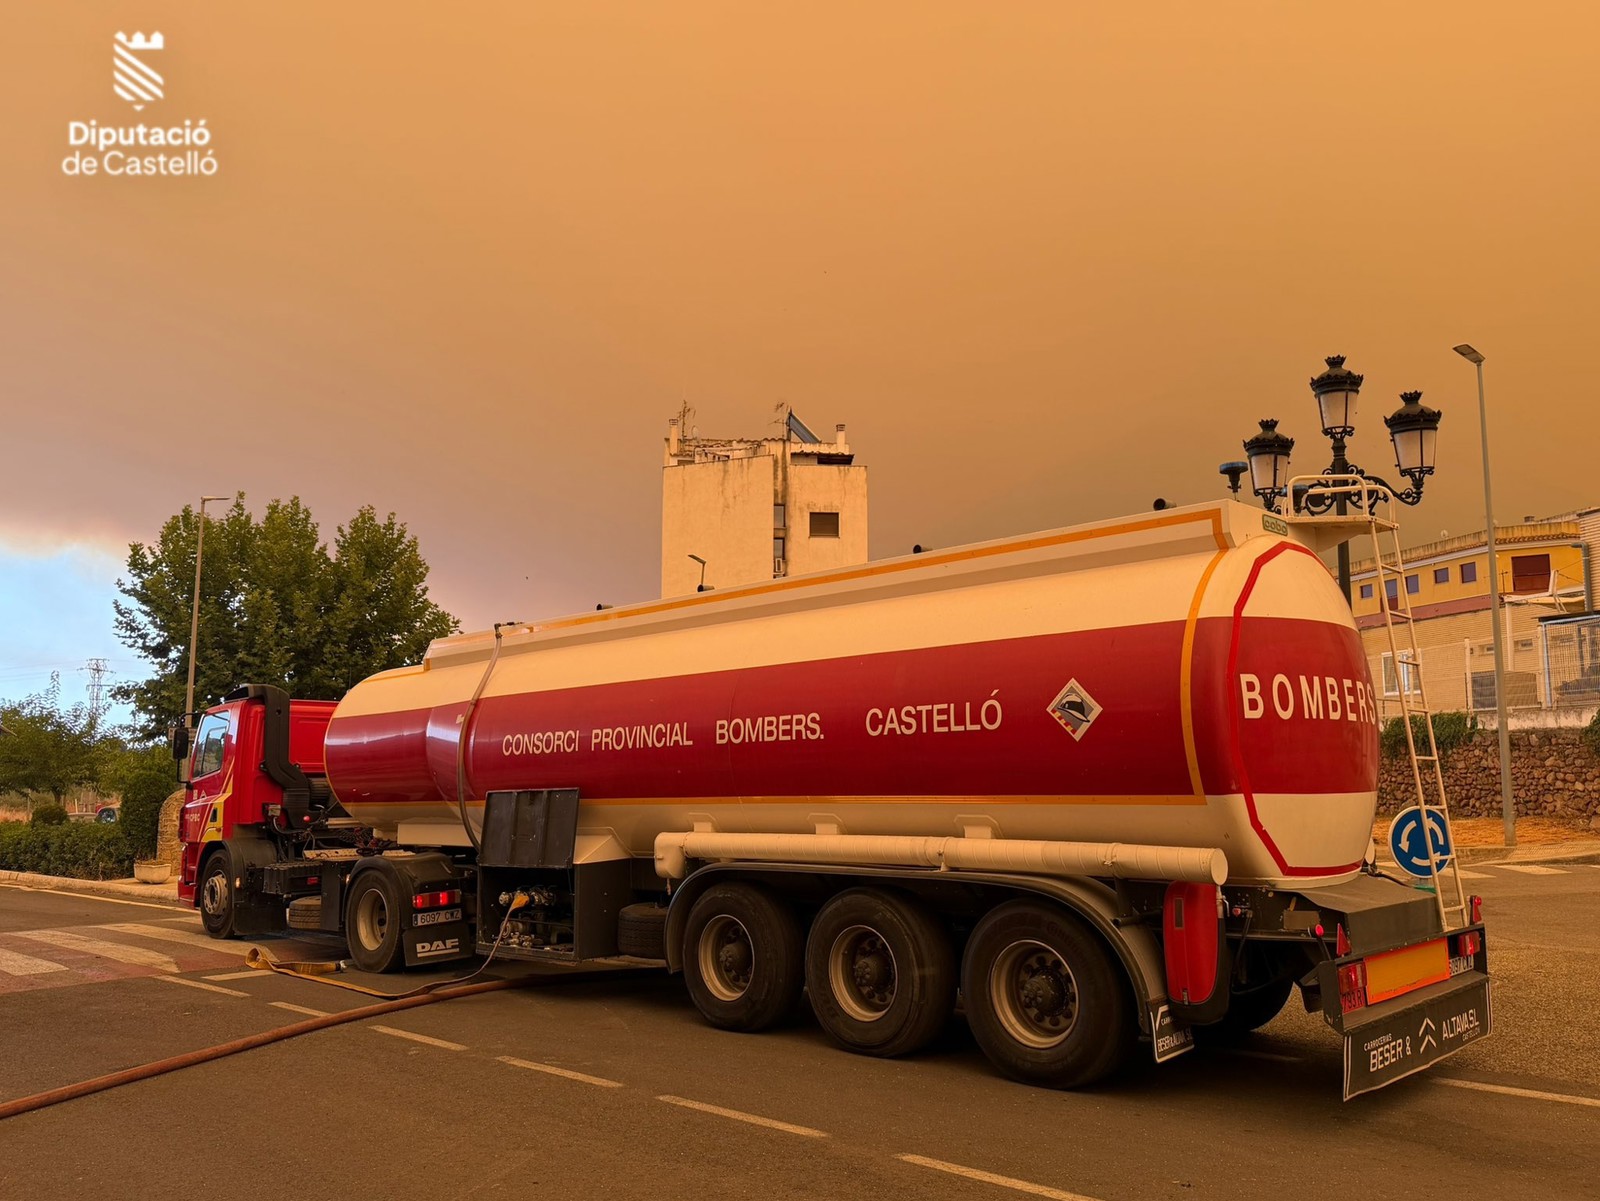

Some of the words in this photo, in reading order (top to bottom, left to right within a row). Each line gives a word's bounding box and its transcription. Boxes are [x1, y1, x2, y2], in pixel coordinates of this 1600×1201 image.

[1239, 673, 1376, 725] BOMBERS
[502, 730, 580, 756] CONSORCI
[591, 722, 694, 751] PROVINCIAL
[716, 713, 825, 745] BOMBERS.
[865, 689, 1002, 737] CASTELLÓ
[420, 912, 441, 924] 6097
[416, 938, 459, 953] DAF
[1370, 1038, 1403, 1072] BESER
[1405, 1035, 1411, 1055] &
